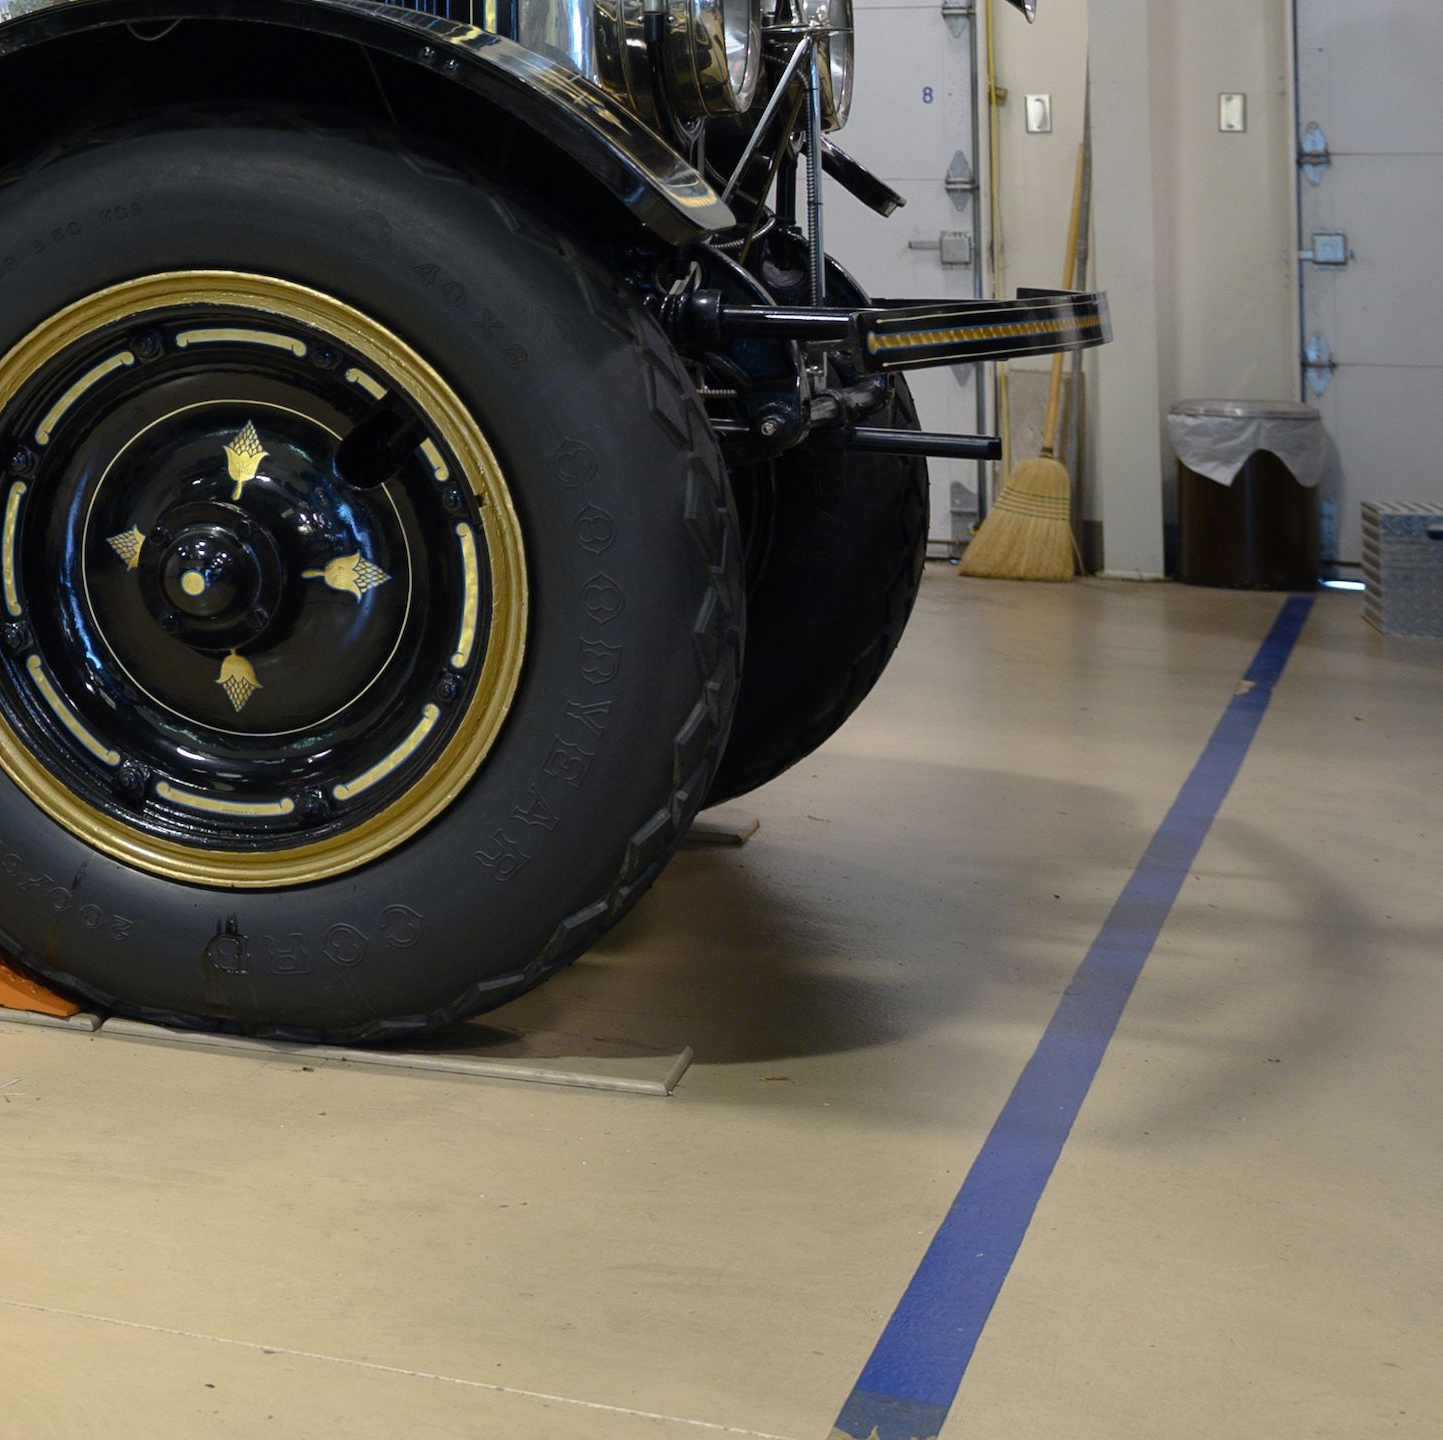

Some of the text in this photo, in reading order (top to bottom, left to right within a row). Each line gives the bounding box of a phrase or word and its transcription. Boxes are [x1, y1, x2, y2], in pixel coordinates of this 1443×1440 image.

[922, 86, 933, 104] 8
[207, 436, 626, 976] GOODYEAR CORD
